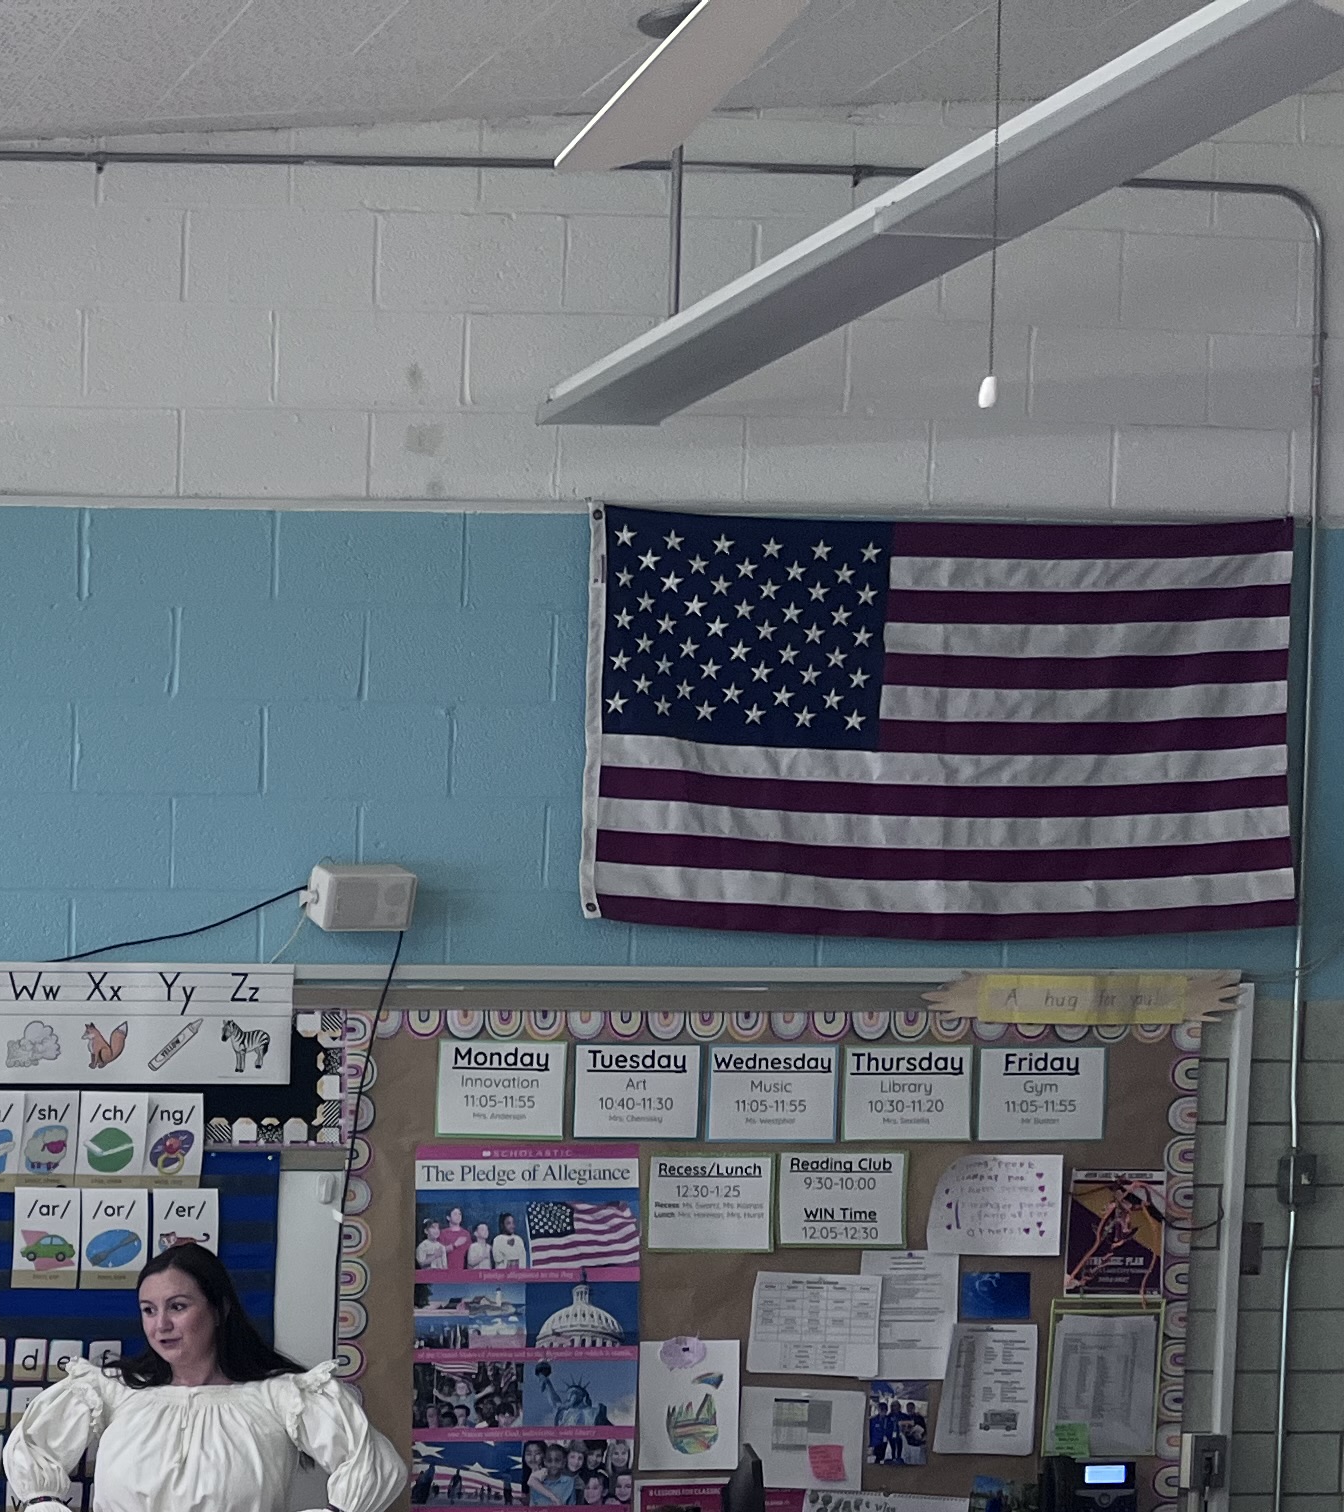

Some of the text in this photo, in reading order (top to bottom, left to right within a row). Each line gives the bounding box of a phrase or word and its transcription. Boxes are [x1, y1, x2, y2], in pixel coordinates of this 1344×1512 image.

[454, 1048, 549, 1071] Monday
[588, 1051, 687, 1073] Tuesday
[714, 1053, 831, 1074] Wednesday
[853, 1054, 963, 1074] Thursday
[1004, 1054, 1079, 1075] Friday
[461, 1075, 539, 1089] Innovation
[626, 1077, 647, 1091] Art
[751, 1080, 792, 1093] Music
[880, 1080, 932, 1095] Library
[1024, 1080, 1058, 1095] Gym
[464, 1095, 535, 1109] 11:05-11:55
[599, 1097, 673, 1111] 10:40-11:30
[735, 1100, 806, 1113] 11:05-11:55
[1004, 1100, 1076, 1113] 11:05-11:55
[659, 1162, 762, 1175] Recess/Lunch
[790, 1158, 892, 1171] Reading Club
[423, 1164, 630, 1185] The Pledge of Allegiance
[804, 1177, 876, 1190] 9:30-10:00
[804, 1208, 876, 1220] WIN Time
[802, 1227, 878, 1239] 12:05-12:30
